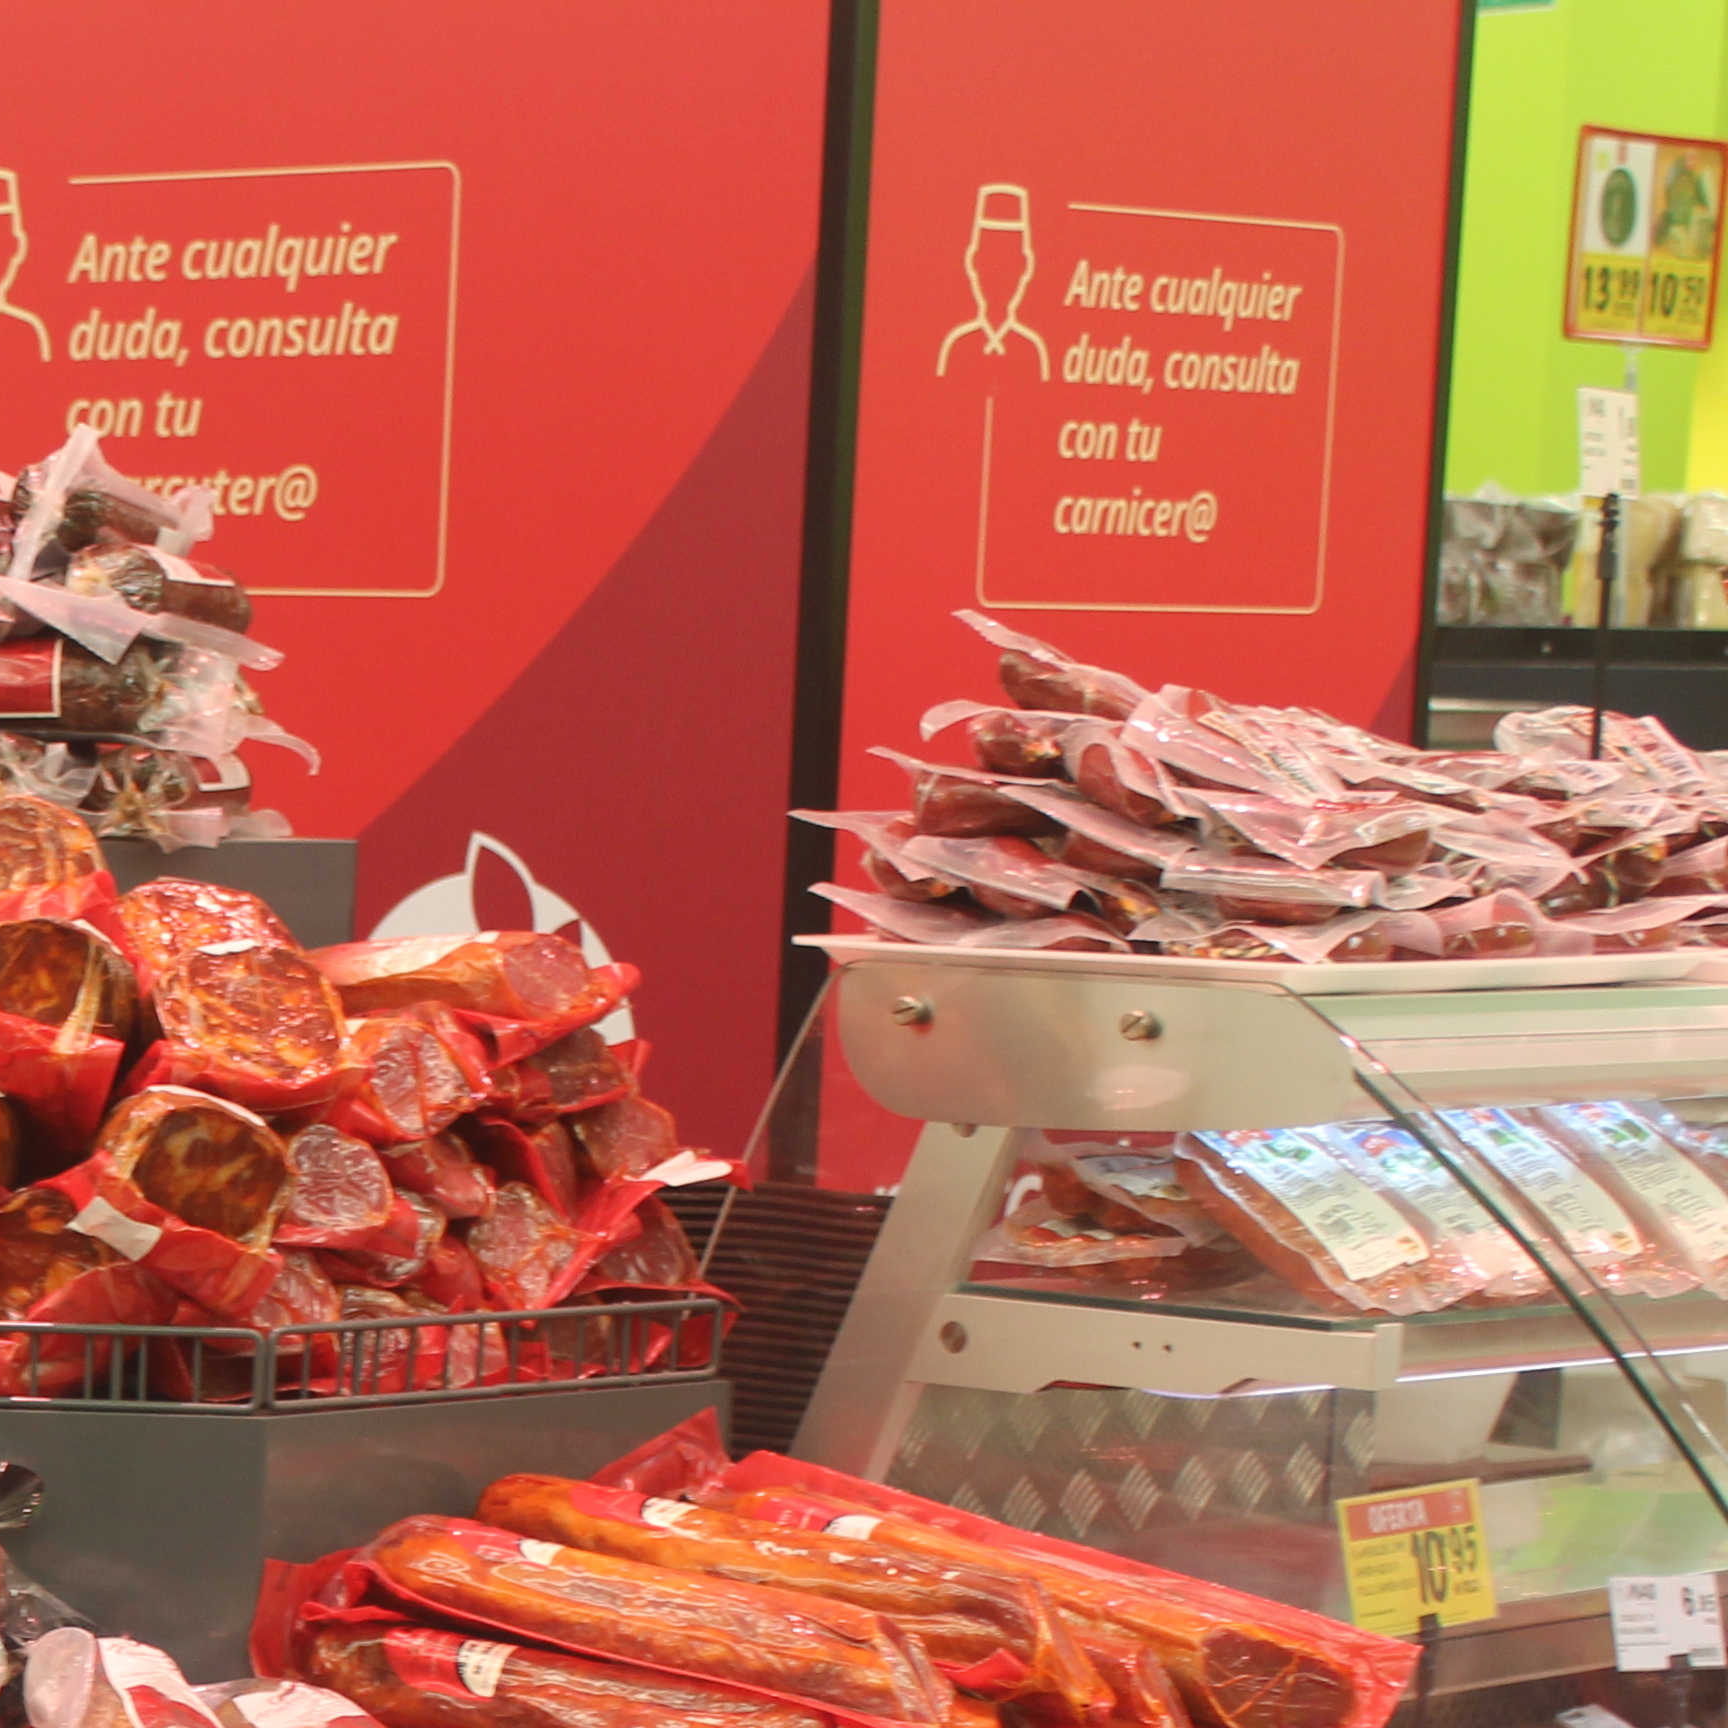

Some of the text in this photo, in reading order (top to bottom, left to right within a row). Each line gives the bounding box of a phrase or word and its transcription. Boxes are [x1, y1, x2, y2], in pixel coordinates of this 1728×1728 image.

[66, 221, 399, 293] Ante cualquier
[1063, 258, 1302, 331] Ante cualquier
[67, 301, 400, 367] duda, consulta
[1061, 334, 1300, 395] duda, consulta
[65, 391, 203, 438] con tu
[1057, 416, 1162, 462] con tu
[1052, 488, 1218, 544] carnicer@
